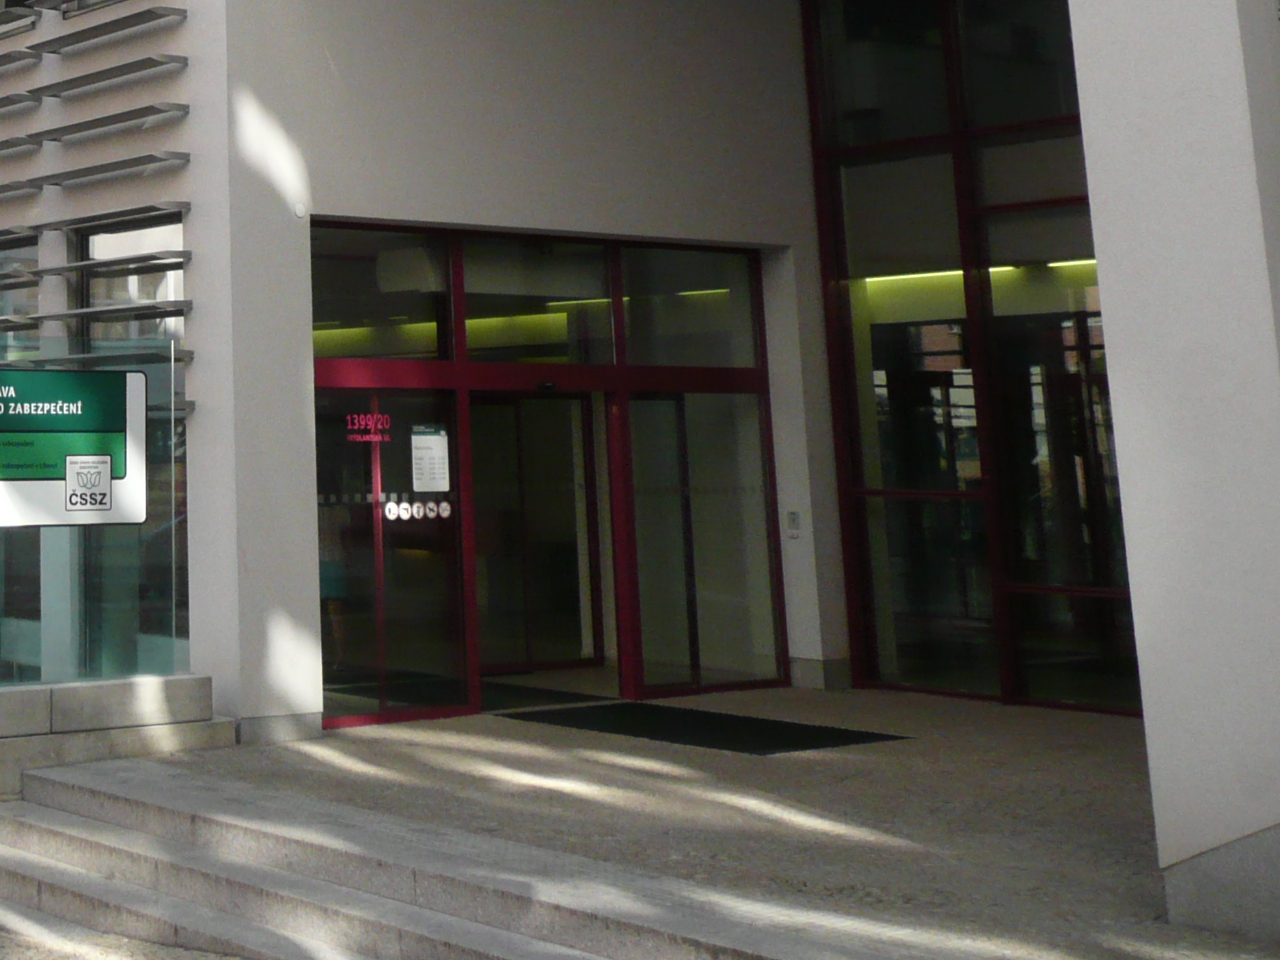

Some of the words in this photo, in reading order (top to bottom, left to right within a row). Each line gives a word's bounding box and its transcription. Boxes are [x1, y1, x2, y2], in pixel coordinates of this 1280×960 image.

[9, 400, 82, 415] ZABEZPEČENÍ
[346, 414, 391, 433] 1399/20
[69, 489, 107, 506] ČSSZ
